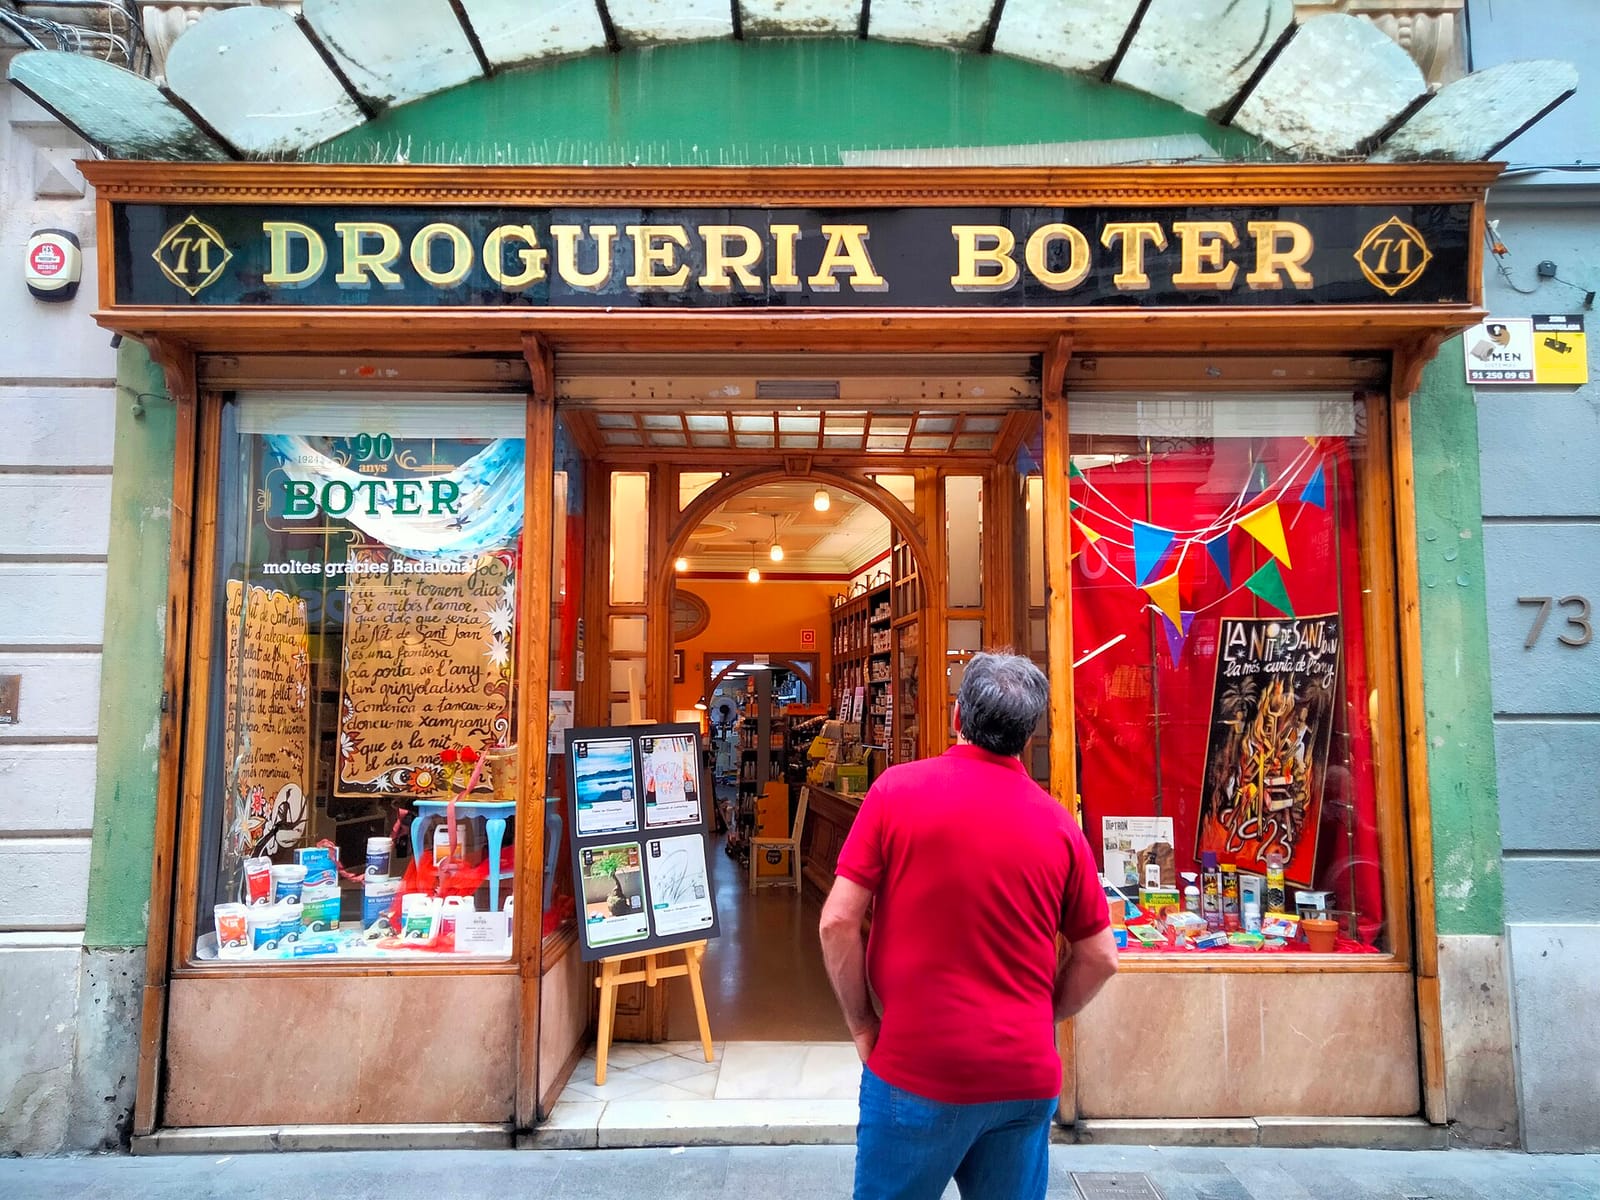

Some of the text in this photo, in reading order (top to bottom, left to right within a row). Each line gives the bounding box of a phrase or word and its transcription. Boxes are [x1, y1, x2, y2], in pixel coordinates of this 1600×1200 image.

[171, 237, 211, 274] 71
[262, 221, 1314, 293] DROGUERIA BOTER
[1372, 238, 1413, 275] 71
[351, 432, 394, 462] 90
[358, 463, 388, 475] anys
[282, 480, 461, 520] BOTER
[263, 560, 321, 574] moltes
[325, 560, 389, 578] gràcies
[391, 559, 476, 575] Badalona!
[416, 578, 464, 598] tornen
[472, 580, 500, 597] dia
[352, 599, 374, 615] Si
[355, 615, 377, 630] que
[383, 612, 411, 626] dolç
[415, 615, 441, 630] que
[1518, 595, 1592, 650] 73
[396, 628, 410, 640] de
[402, 624, 449, 646] Sant
[1223, 621, 1248, 661] LA
[1287, 620, 1326, 652] SANT
[373, 663, 416, 687] porta
[1223, 660, 1242, 678] la
[1242, 660, 1260, 676] més
[1263, 653, 1295, 674] curta
[1295, 653, 1306, 673] de
[422, 703, 433, 712] a
[359, 738, 387, 765] que
[408, 730, 425, 749] la
[428, 734, 452, 750] nit
[384, 752, 412, 767] dia
